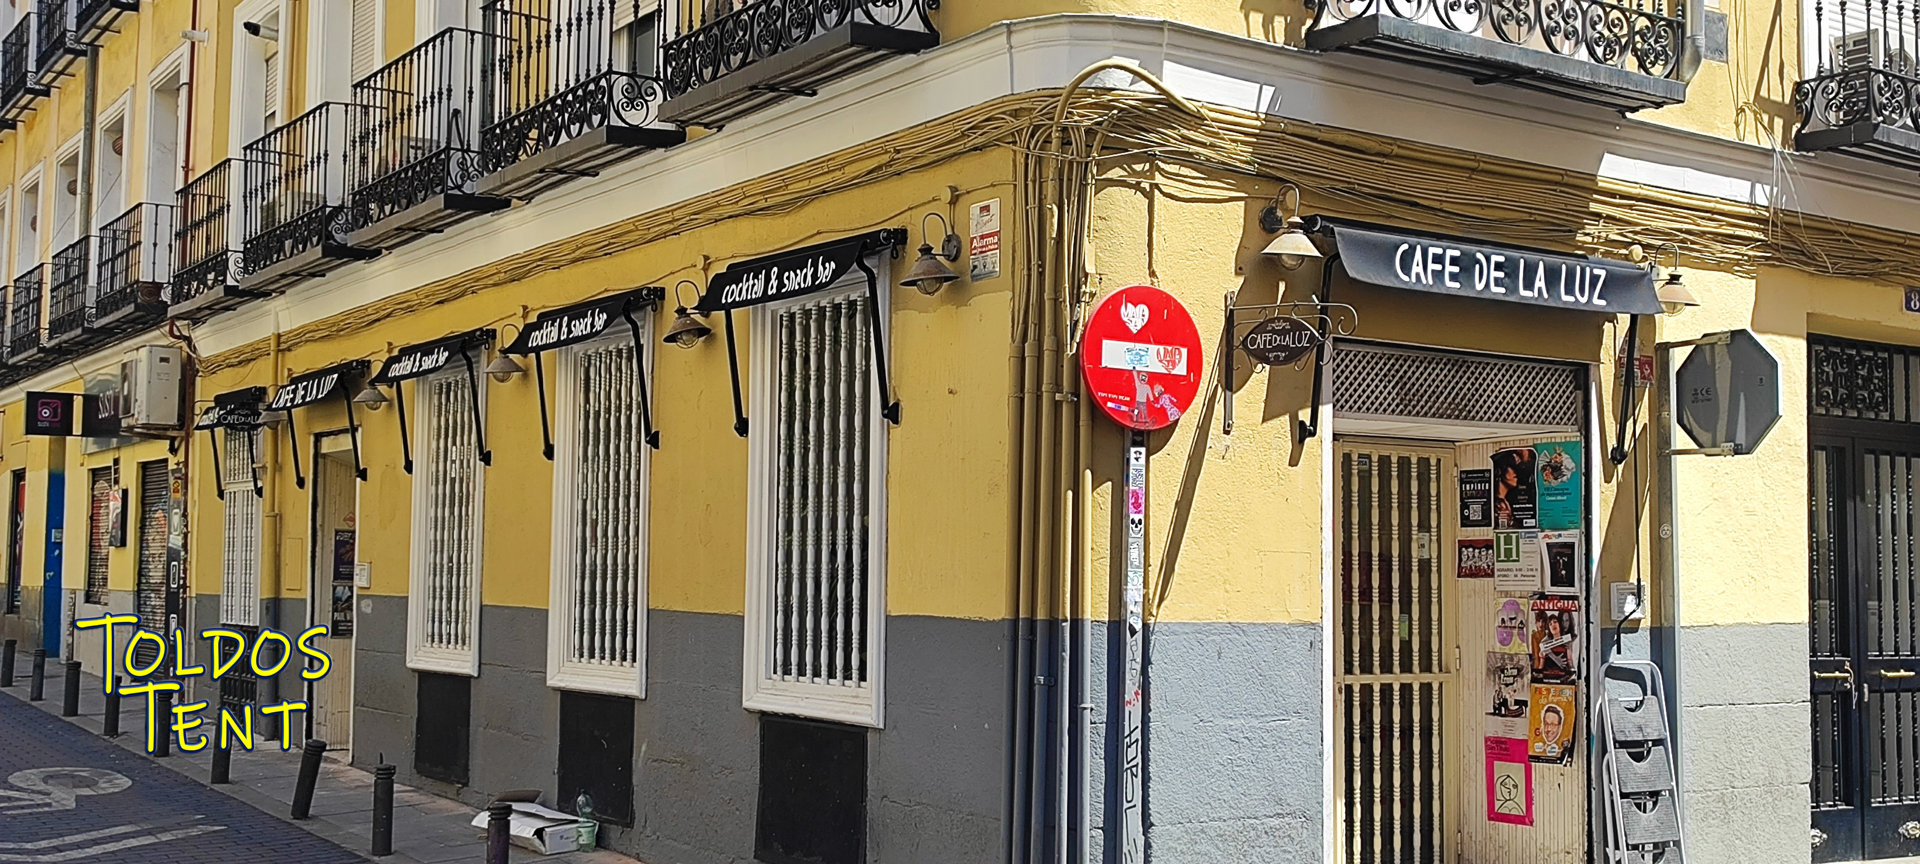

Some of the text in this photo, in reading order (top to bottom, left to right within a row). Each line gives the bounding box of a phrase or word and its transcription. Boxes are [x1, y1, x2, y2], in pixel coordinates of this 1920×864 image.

[971, 235, 998, 249] Alarma
[721, 256, 836, 304] cocktail & snack bar
[1395, 243, 1607, 306] CAFE DE LA LUZ
[528, 308, 607, 347] cocktail & snack bar
[1247, 333, 1272, 349] CAFE
[1290, 331, 1310, 347] LUZ
[388, 347, 448, 377] cocktail & snack bar
[272, 374, 338, 408] CAFE DE LA LUZ
[1497, 533, 1519, 560] H
[1532, 600, 1578, 611] ANTIGUA
